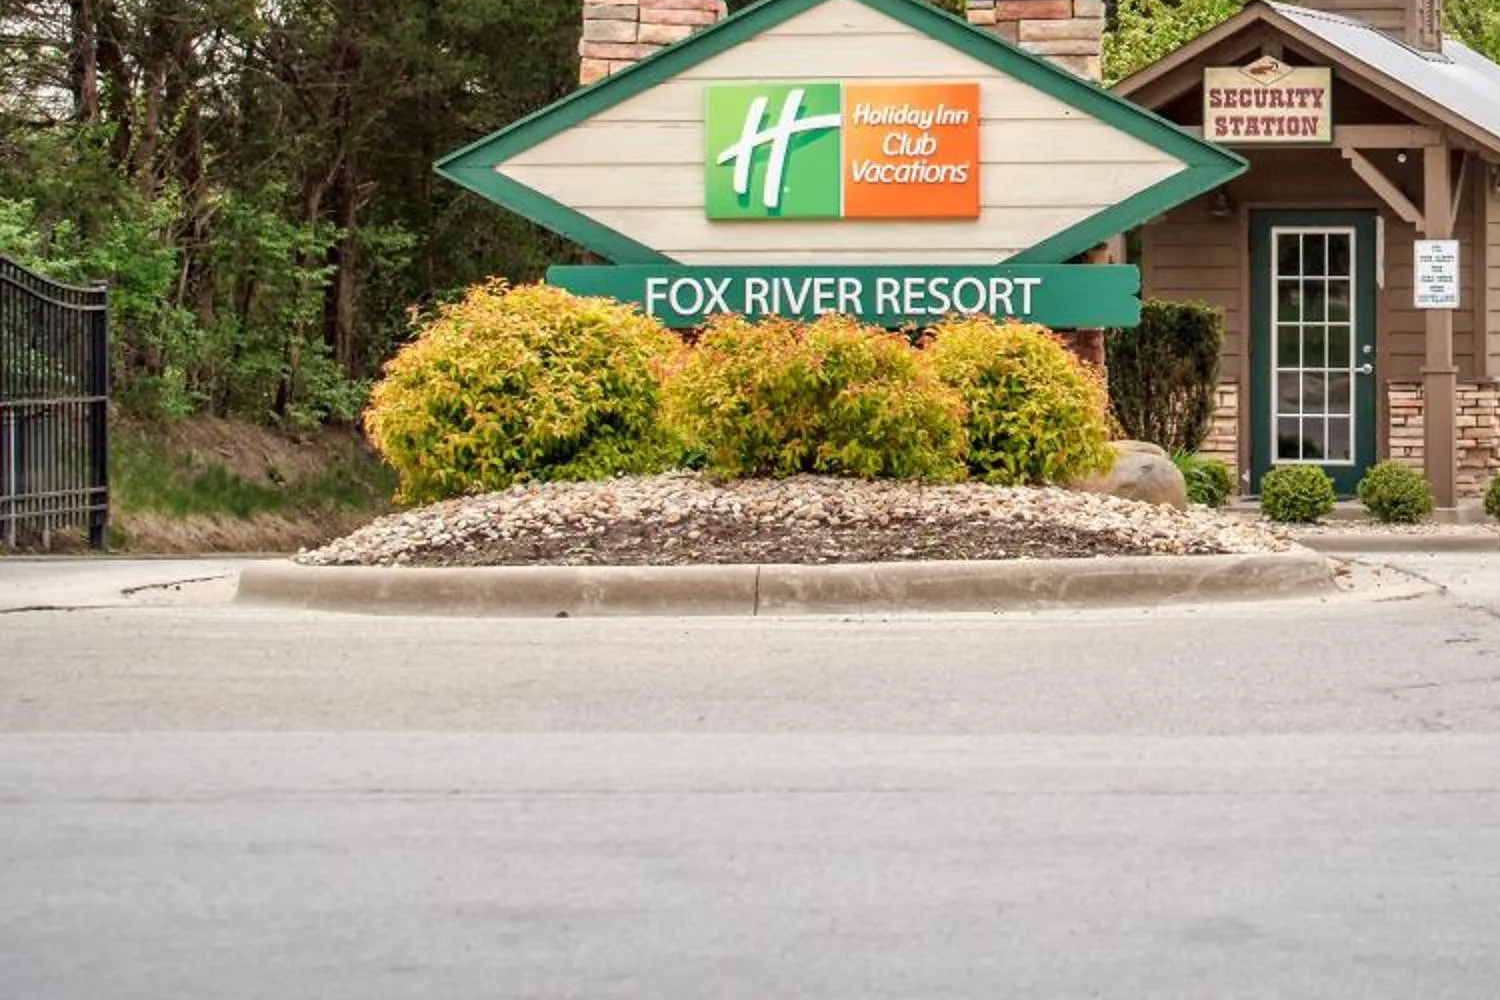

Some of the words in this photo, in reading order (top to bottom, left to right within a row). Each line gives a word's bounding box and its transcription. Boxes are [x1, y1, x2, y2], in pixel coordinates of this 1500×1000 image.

[1208, 87, 1325, 109] SECURITY
[852, 103, 934, 130] Holiday
[935, 103, 970, 125] Inn
[1214, 115, 1319, 137] STATION
[882, 130, 938, 157] Club
[851, 160, 969, 184] Vacations
[645, 276, 732, 316] FOX
[744, 276, 864, 316] RIVER
[875, 276, 1042, 316] RESORT
